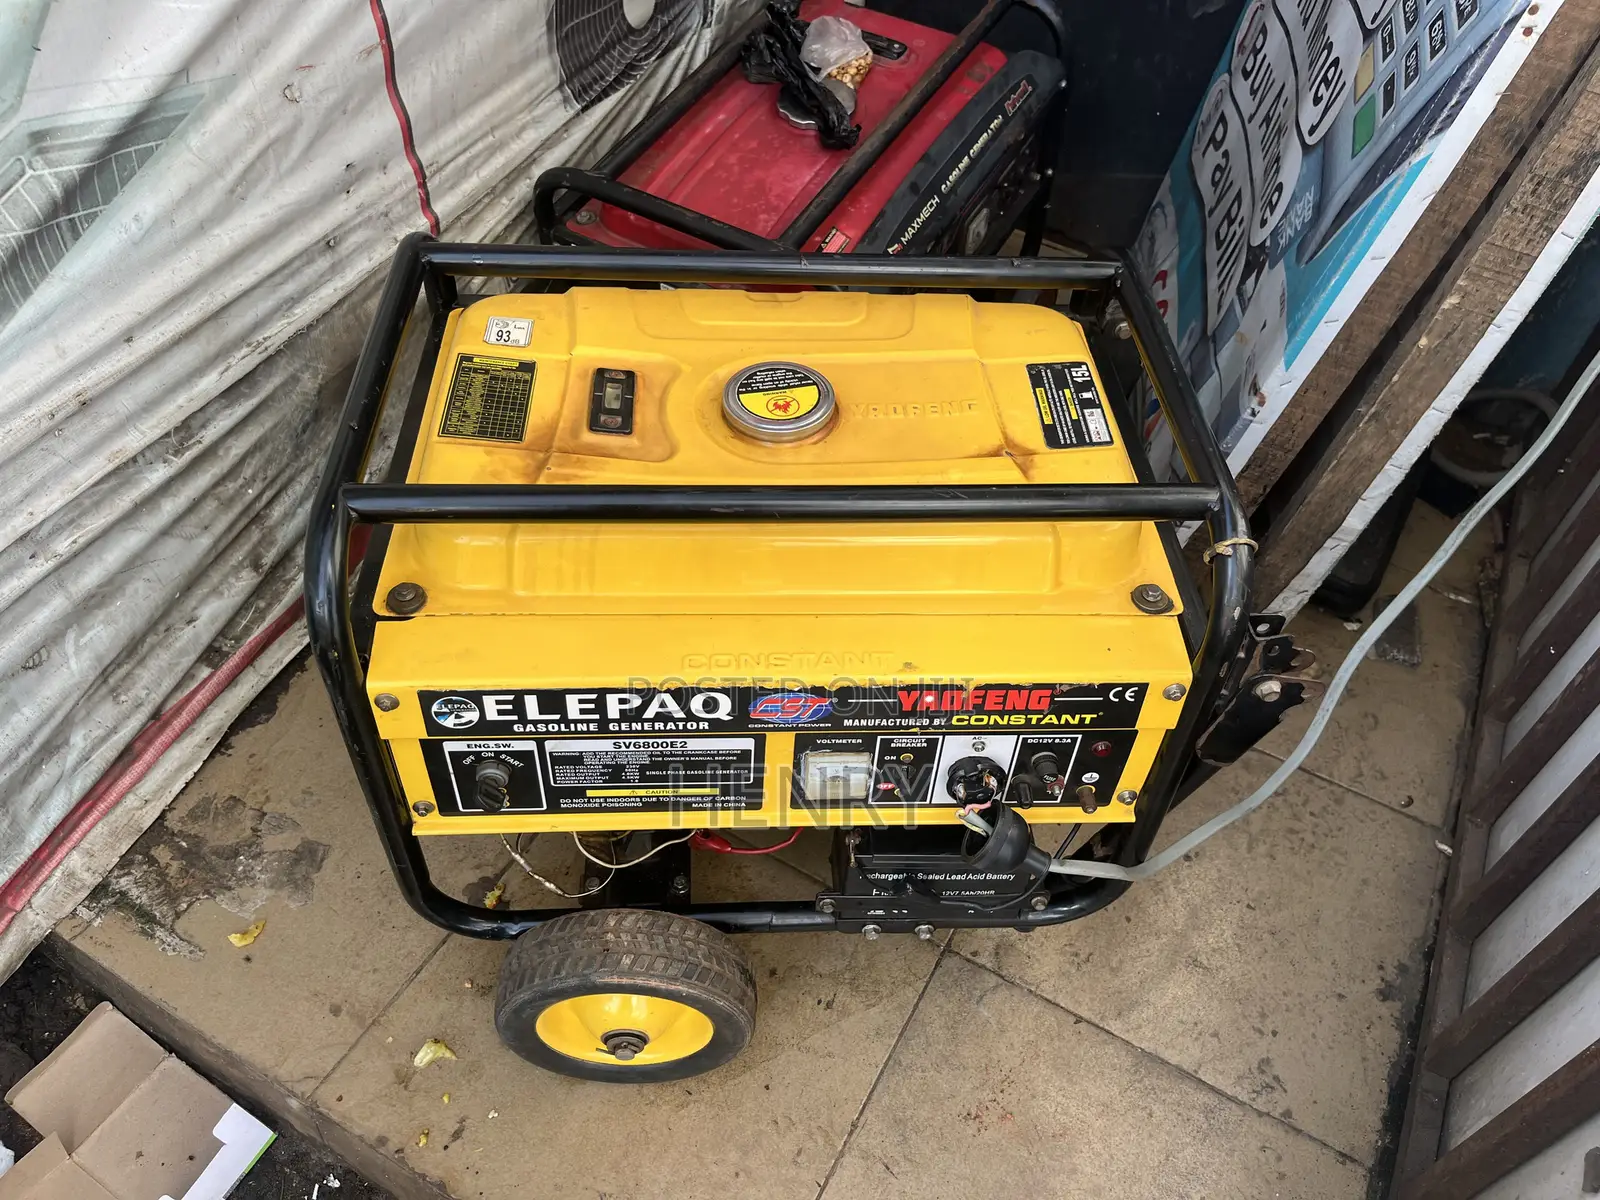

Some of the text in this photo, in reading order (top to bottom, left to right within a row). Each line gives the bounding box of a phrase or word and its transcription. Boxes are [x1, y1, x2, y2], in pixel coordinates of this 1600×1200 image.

[1241, 21, 1276, 125] Buy
[1202, 109, 1234, 219] Pay
[1258, 81, 1288, 230] Airtime
[900, 114, 1003, 245] MAXMECH GASOLINE GENERATOR
[495, 329, 511, 343] 93
[1070, 364, 1092, 384] 15L
[681, 652, 896, 672] CONSTANT
[481, 692, 734, 721] ELEPAQ
[897, 689, 1054, 712] YAOFENG
[512, 720, 710, 732] GASOLINE GENERATOR
[843, 714, 1099, 727] MANUFACTURED BY CONSTANT
[612, 740, 688, 750] SV6800E2
[462, 754, 476, 766] OFF
[499, 753, 525, 768] START
[916, 872, 945, 880] Sealed
[986, 873, 1016, 881] Battery
